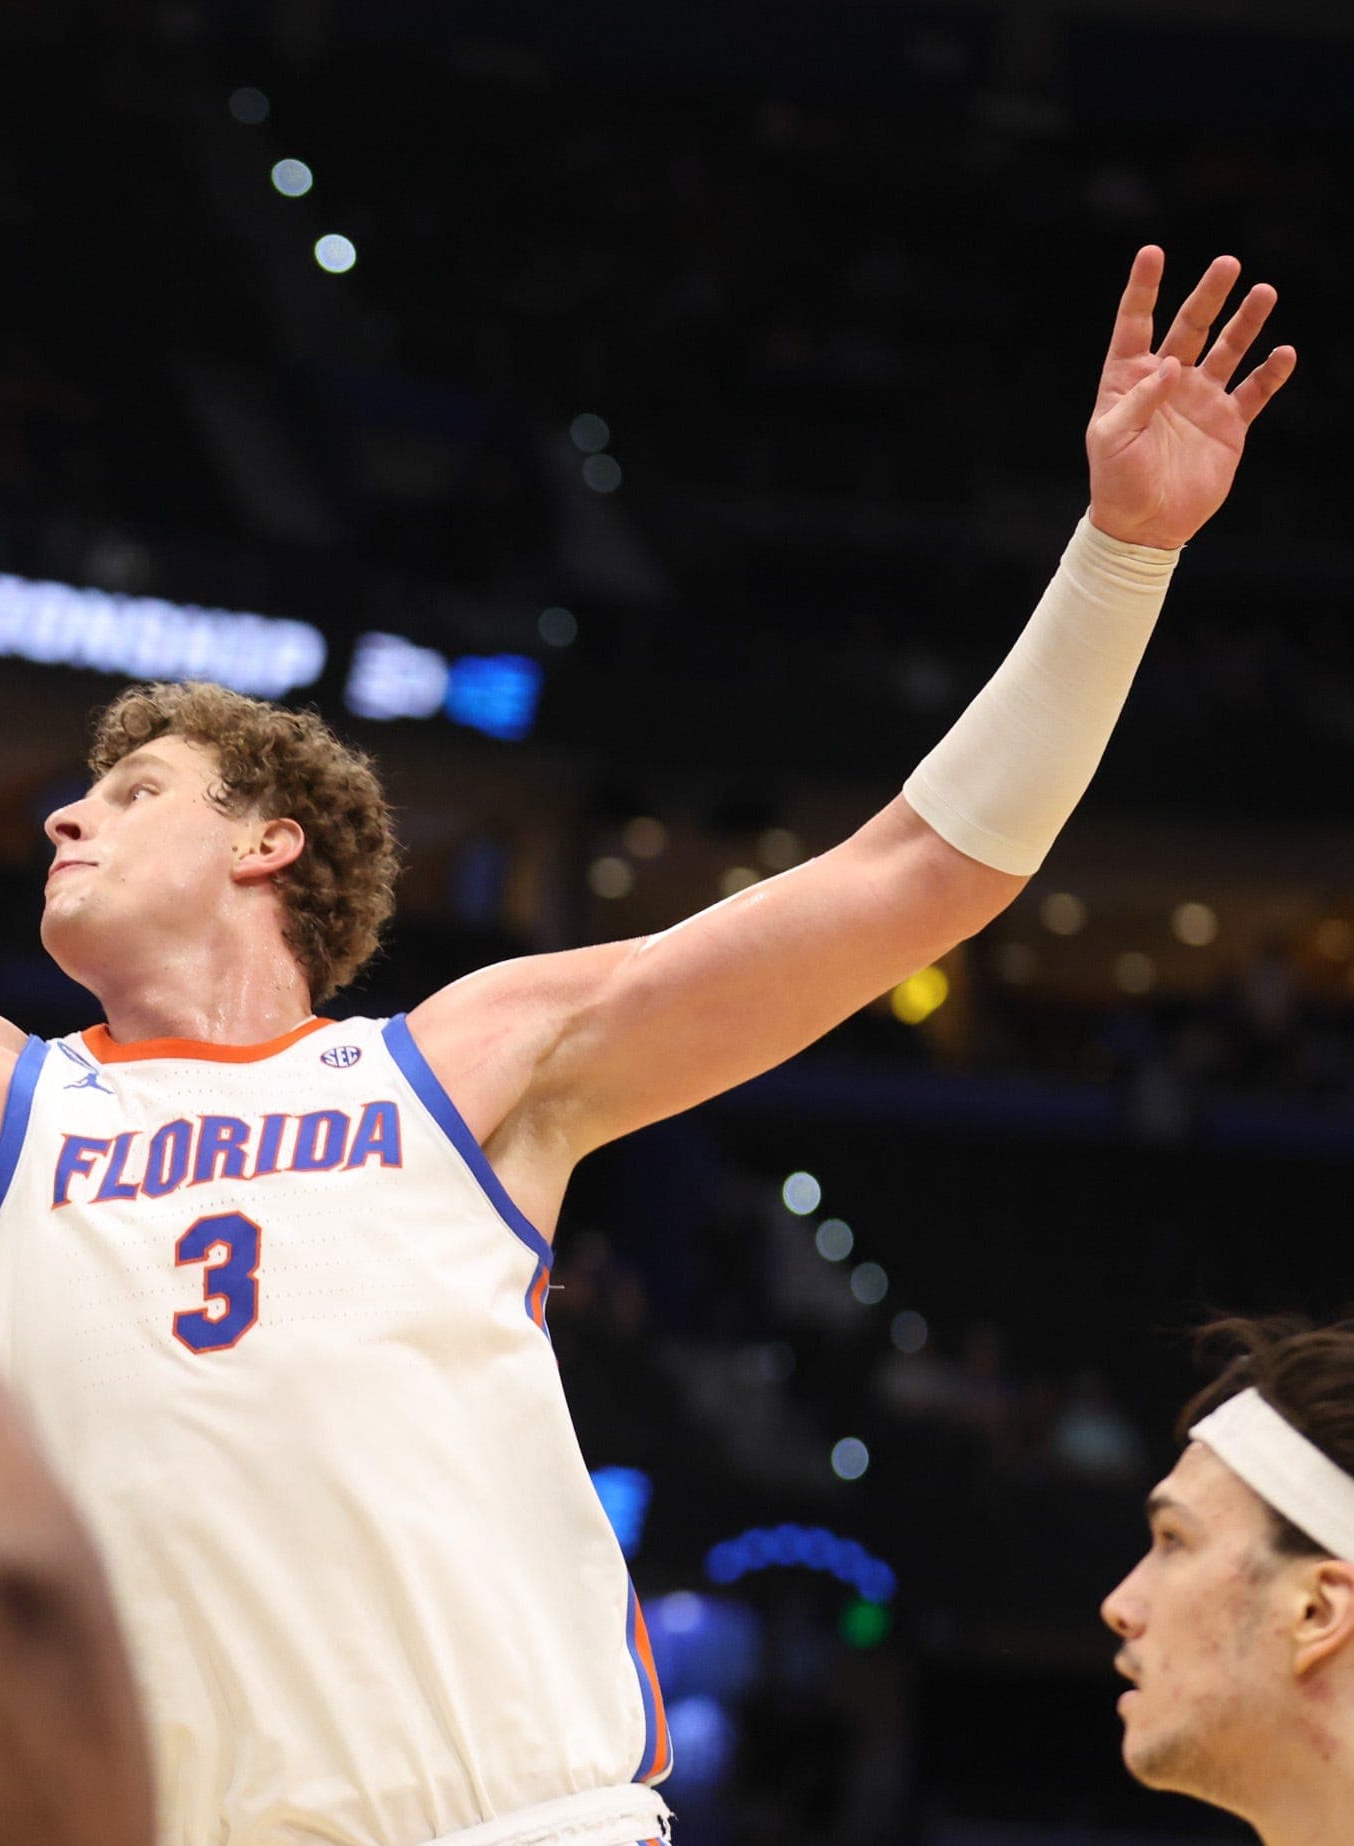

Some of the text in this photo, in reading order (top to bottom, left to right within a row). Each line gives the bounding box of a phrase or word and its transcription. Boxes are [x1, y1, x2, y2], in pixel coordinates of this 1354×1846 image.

[321, 1046, 361, 1068] SEC
[51, 1100, 404, 1210] FLORIDA
[172, 1210, 262, 1355] 3
